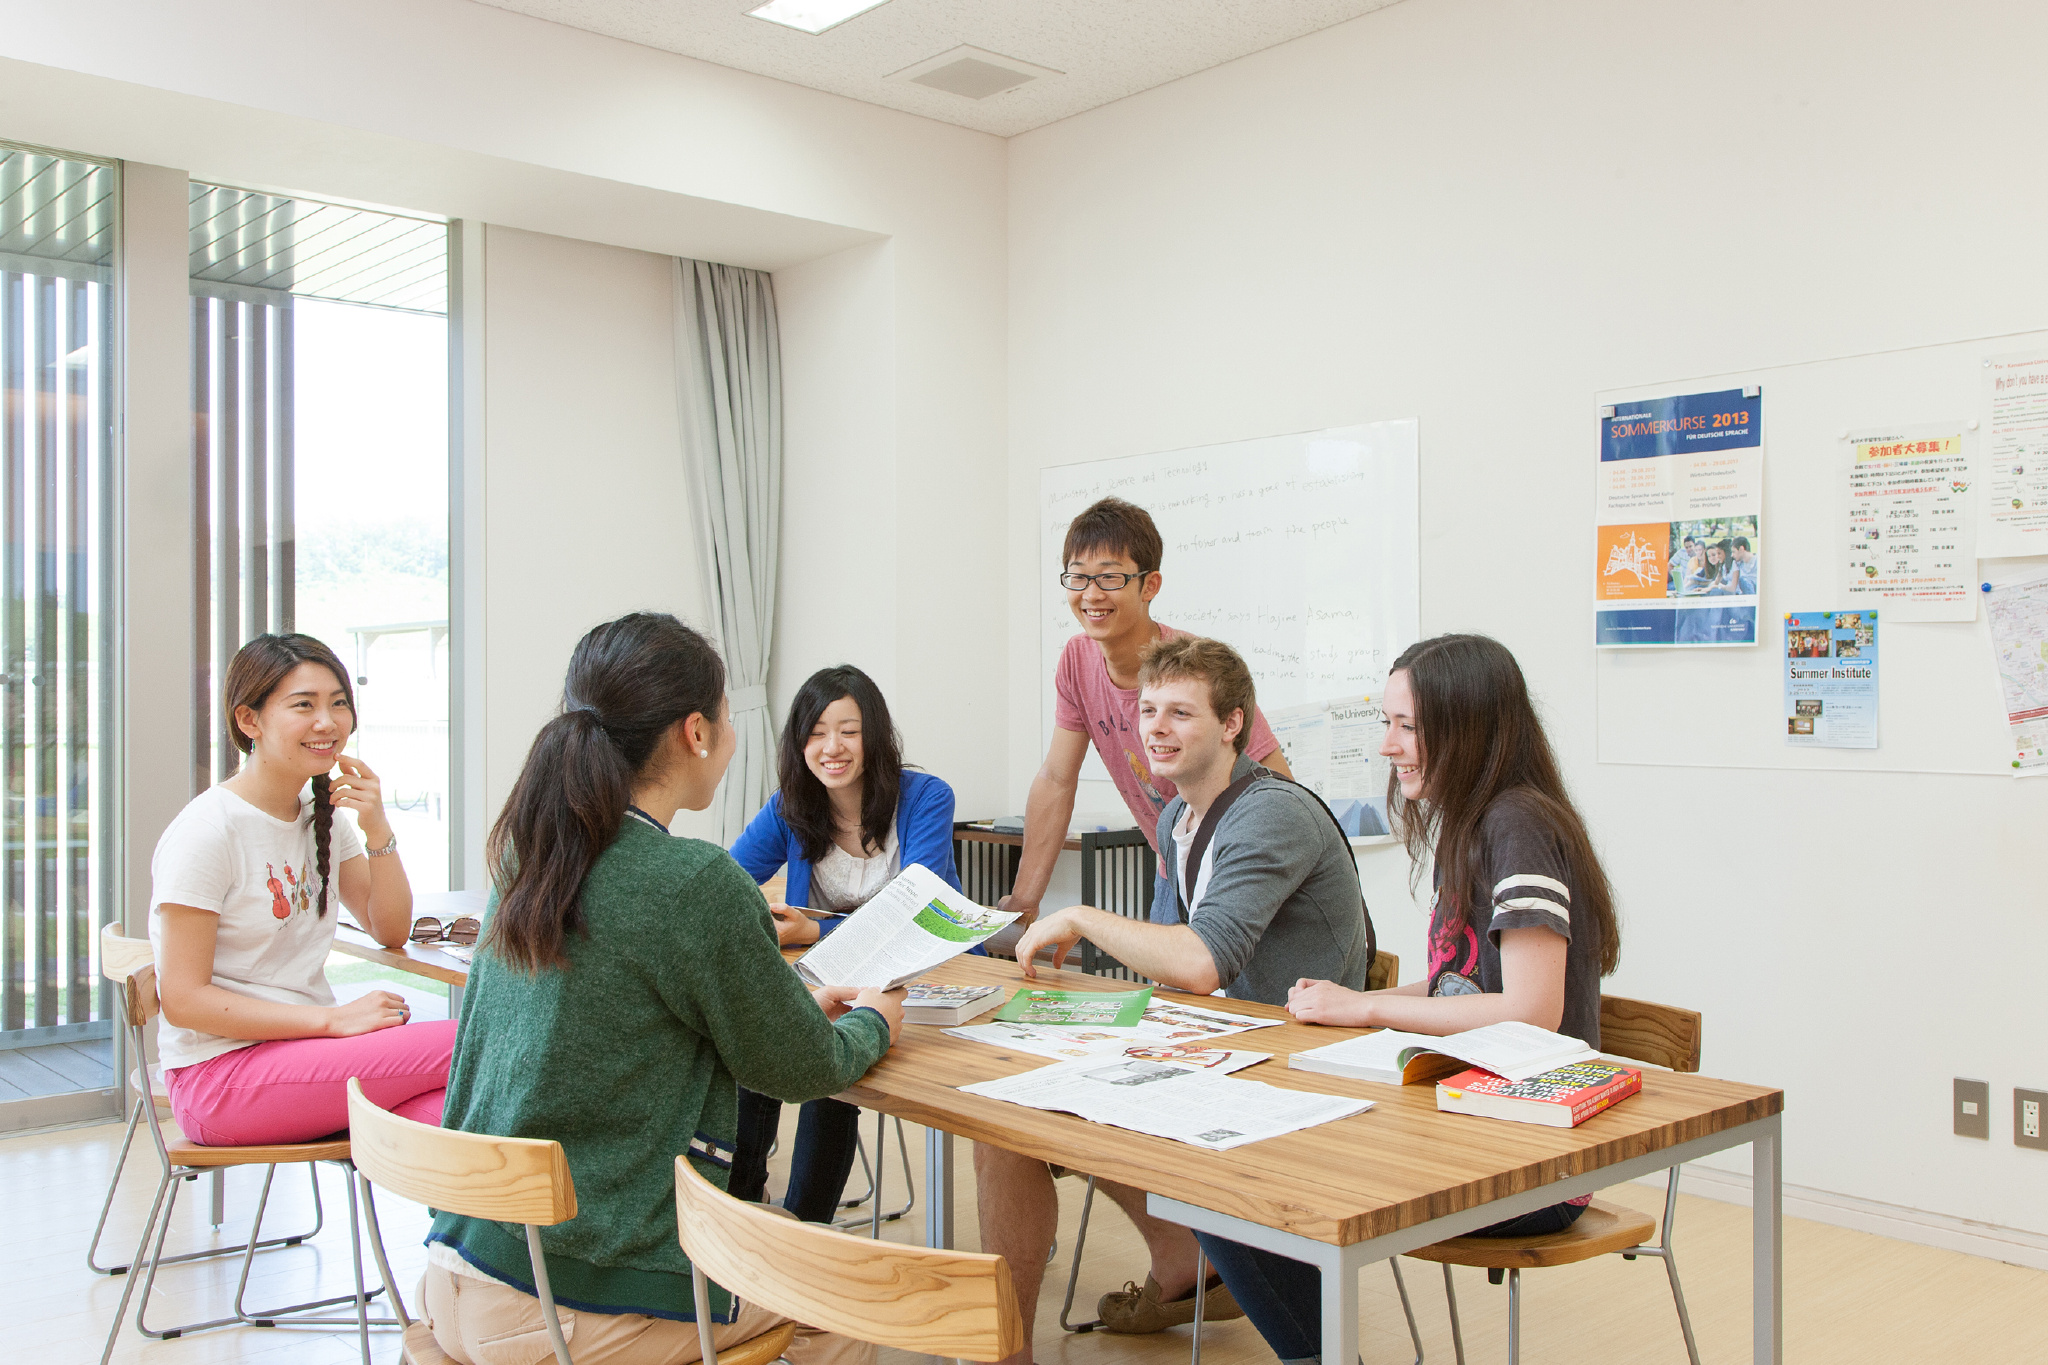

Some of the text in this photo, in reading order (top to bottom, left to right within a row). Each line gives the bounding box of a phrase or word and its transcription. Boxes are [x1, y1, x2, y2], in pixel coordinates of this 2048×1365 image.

[1611, 411, 1749, 438] SOMMERKURSE 2013
[1697, 431, 1724, 439] DEUTSCHE
[1725, 428, 1749, 437] SPRACHE
[1868, 440, 1950, 458] 参加者大募集！
[1161, 461, 1208, 478] Technology
[1221, 531, 1241, 544] and
[1312, 516, 1350, 540] people
[1790, 666, 1871, 679] Summer Institute
[1331, 706, 1381, 721] The University
[1538, 1078, 1591, 1088] LACAN
[1464, 1085, 1563, 1102] EVERYTHING
